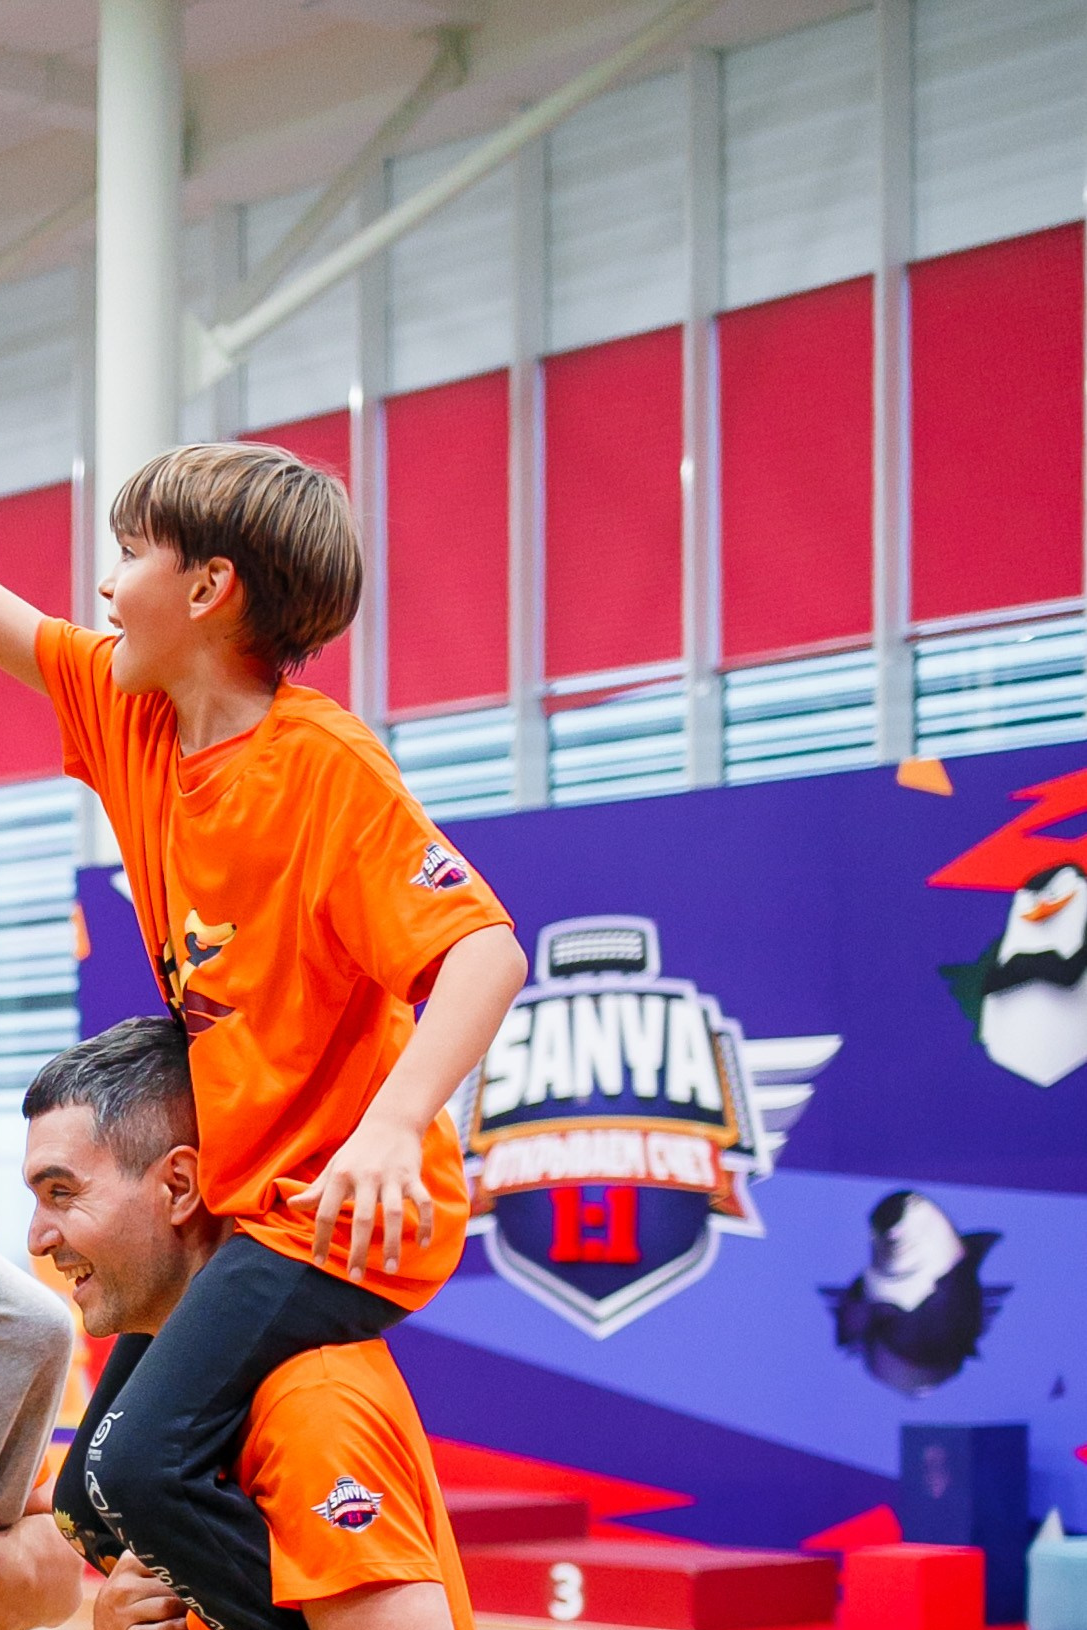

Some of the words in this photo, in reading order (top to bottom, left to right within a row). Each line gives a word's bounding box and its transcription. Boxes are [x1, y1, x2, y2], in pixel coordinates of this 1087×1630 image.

[481, 992, 724, 1119] SANYA
[548, 1185, 642, 1264] 1:1
[329, 1485, 370, 1508] SANYA
[547, 1561, 585, 1621] 3
